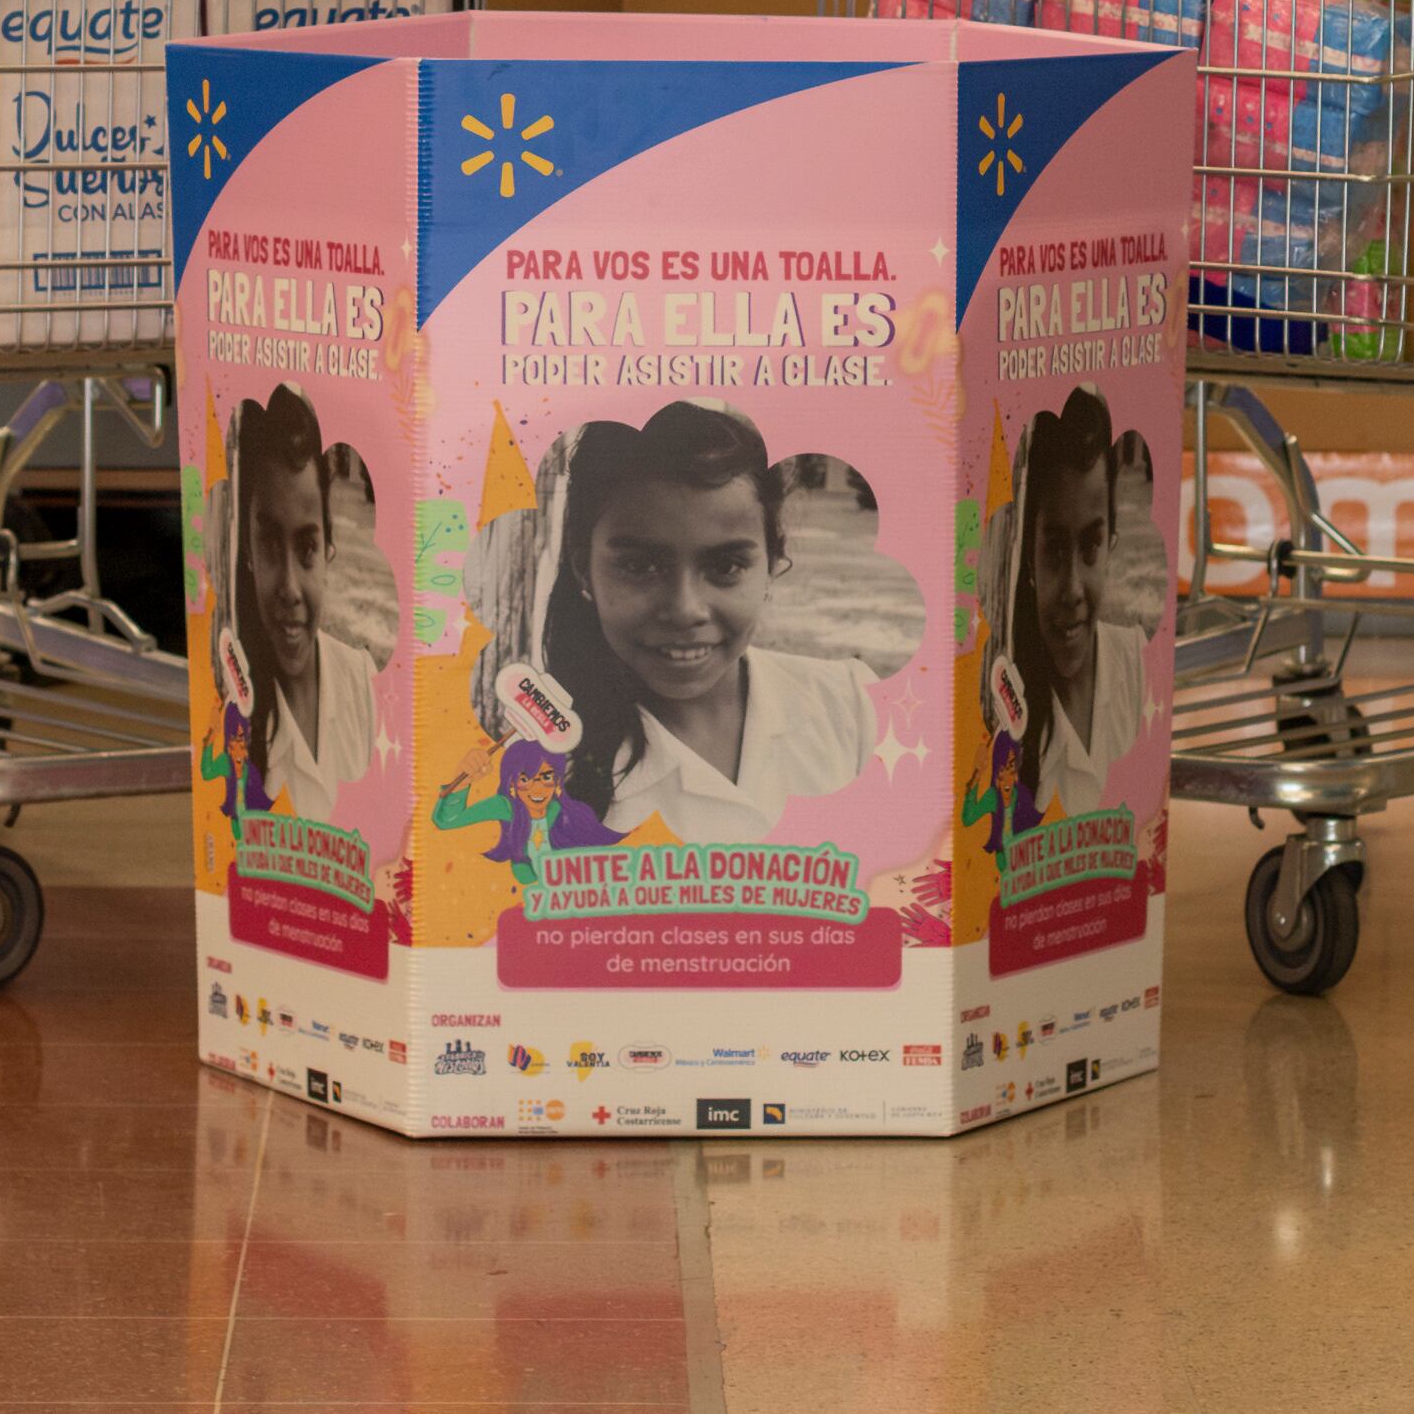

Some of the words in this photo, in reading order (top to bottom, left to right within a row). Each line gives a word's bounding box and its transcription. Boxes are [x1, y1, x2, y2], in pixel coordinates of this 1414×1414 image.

[208, 229, 240, 261] PARA
[243, 233, 269, 265] VOS
[272, 236, 291, 267] ES
[295, 239, 323, 270] UNA
[326, 241, 385, 276] TOALLA.
[506, 249, 584, 281] PARA
[592, 249, 651, 281] VOS
[661, 250, 700, 281] ES
[710, 250, 770, 281] UNA
[778, 250, 898, 281] TOALLA.
[999, 245, 1036, 277] PARA
[1039, 242, 1066, 273] VOS
[1070, 241, 1087, 271] ES
[1091, 237, 1117, 268] UNA
[207, 268, 267, 328] PARA
[273, 276, 339, 338] ELLA
[345, 285, 385, 341] ES
[501, 290, 646, 347] PARA
[663, 290, 806, 348] ELLA
[820, 290, 897, 348] ES
[998, 283, 1064, 343] PARA
[1070, 275, 1132, 334] ELLA
[1136, 272, 1168, 327] ES
[207, 329, 251, 365] PODER
[254, 336, 311, 373] ASISTIR
[314, 342, 325, 375] A
[327, 343, 383, 381] CLASE.
[502, 353, 608, 386] PODER
[616, 353, 746, 387] ASISTIR
[753, 353, 776, 387] A
[781, 354, 894, 387] CLASE.
[517, 677, 571, 733] CAMBIEMOS
[544, 853, 629, 887] UNITE
[639, 851, 657, 882] A
[665, 851, 698, 882] LA
[708, 848, 851, 888] DONACIÓN
[529, 891, 544, 913] Y
[549, 883, 611, 911] AYUDÁ
[616, 887, 631, 907] A
[634, 887, 673, 906] QUE
[678, 885, 735, 905] MILES
[741, 886, 765, 905] DE
[774, 887, 861, 917] MUJERES
[535, 928, 564, 946] no
[570, 925, 655, 949] pierdan
[661, 925, 730, 946] clases
[736, 928, 763, 946] en
[769, 928, 805, 946] sus
[812, 924, 856, 946] días
[605, 953, 634, 973] de
[640, 952, 792, 973] menstruación
[431, 1013, 502, 1028] ORGANIZAN
[579, 1052, 606, 1063] SOY
[712, 1048, 755, 1059] Walmart
[780, 1050, 831, 1066] equate
[431, 1115, 505, 1130] COLABORAN
[617, 1106, 641, 1116] Cruz
[643, 1106, 667, 1117] Roja
[707, 1106, 740, 1122] imc
